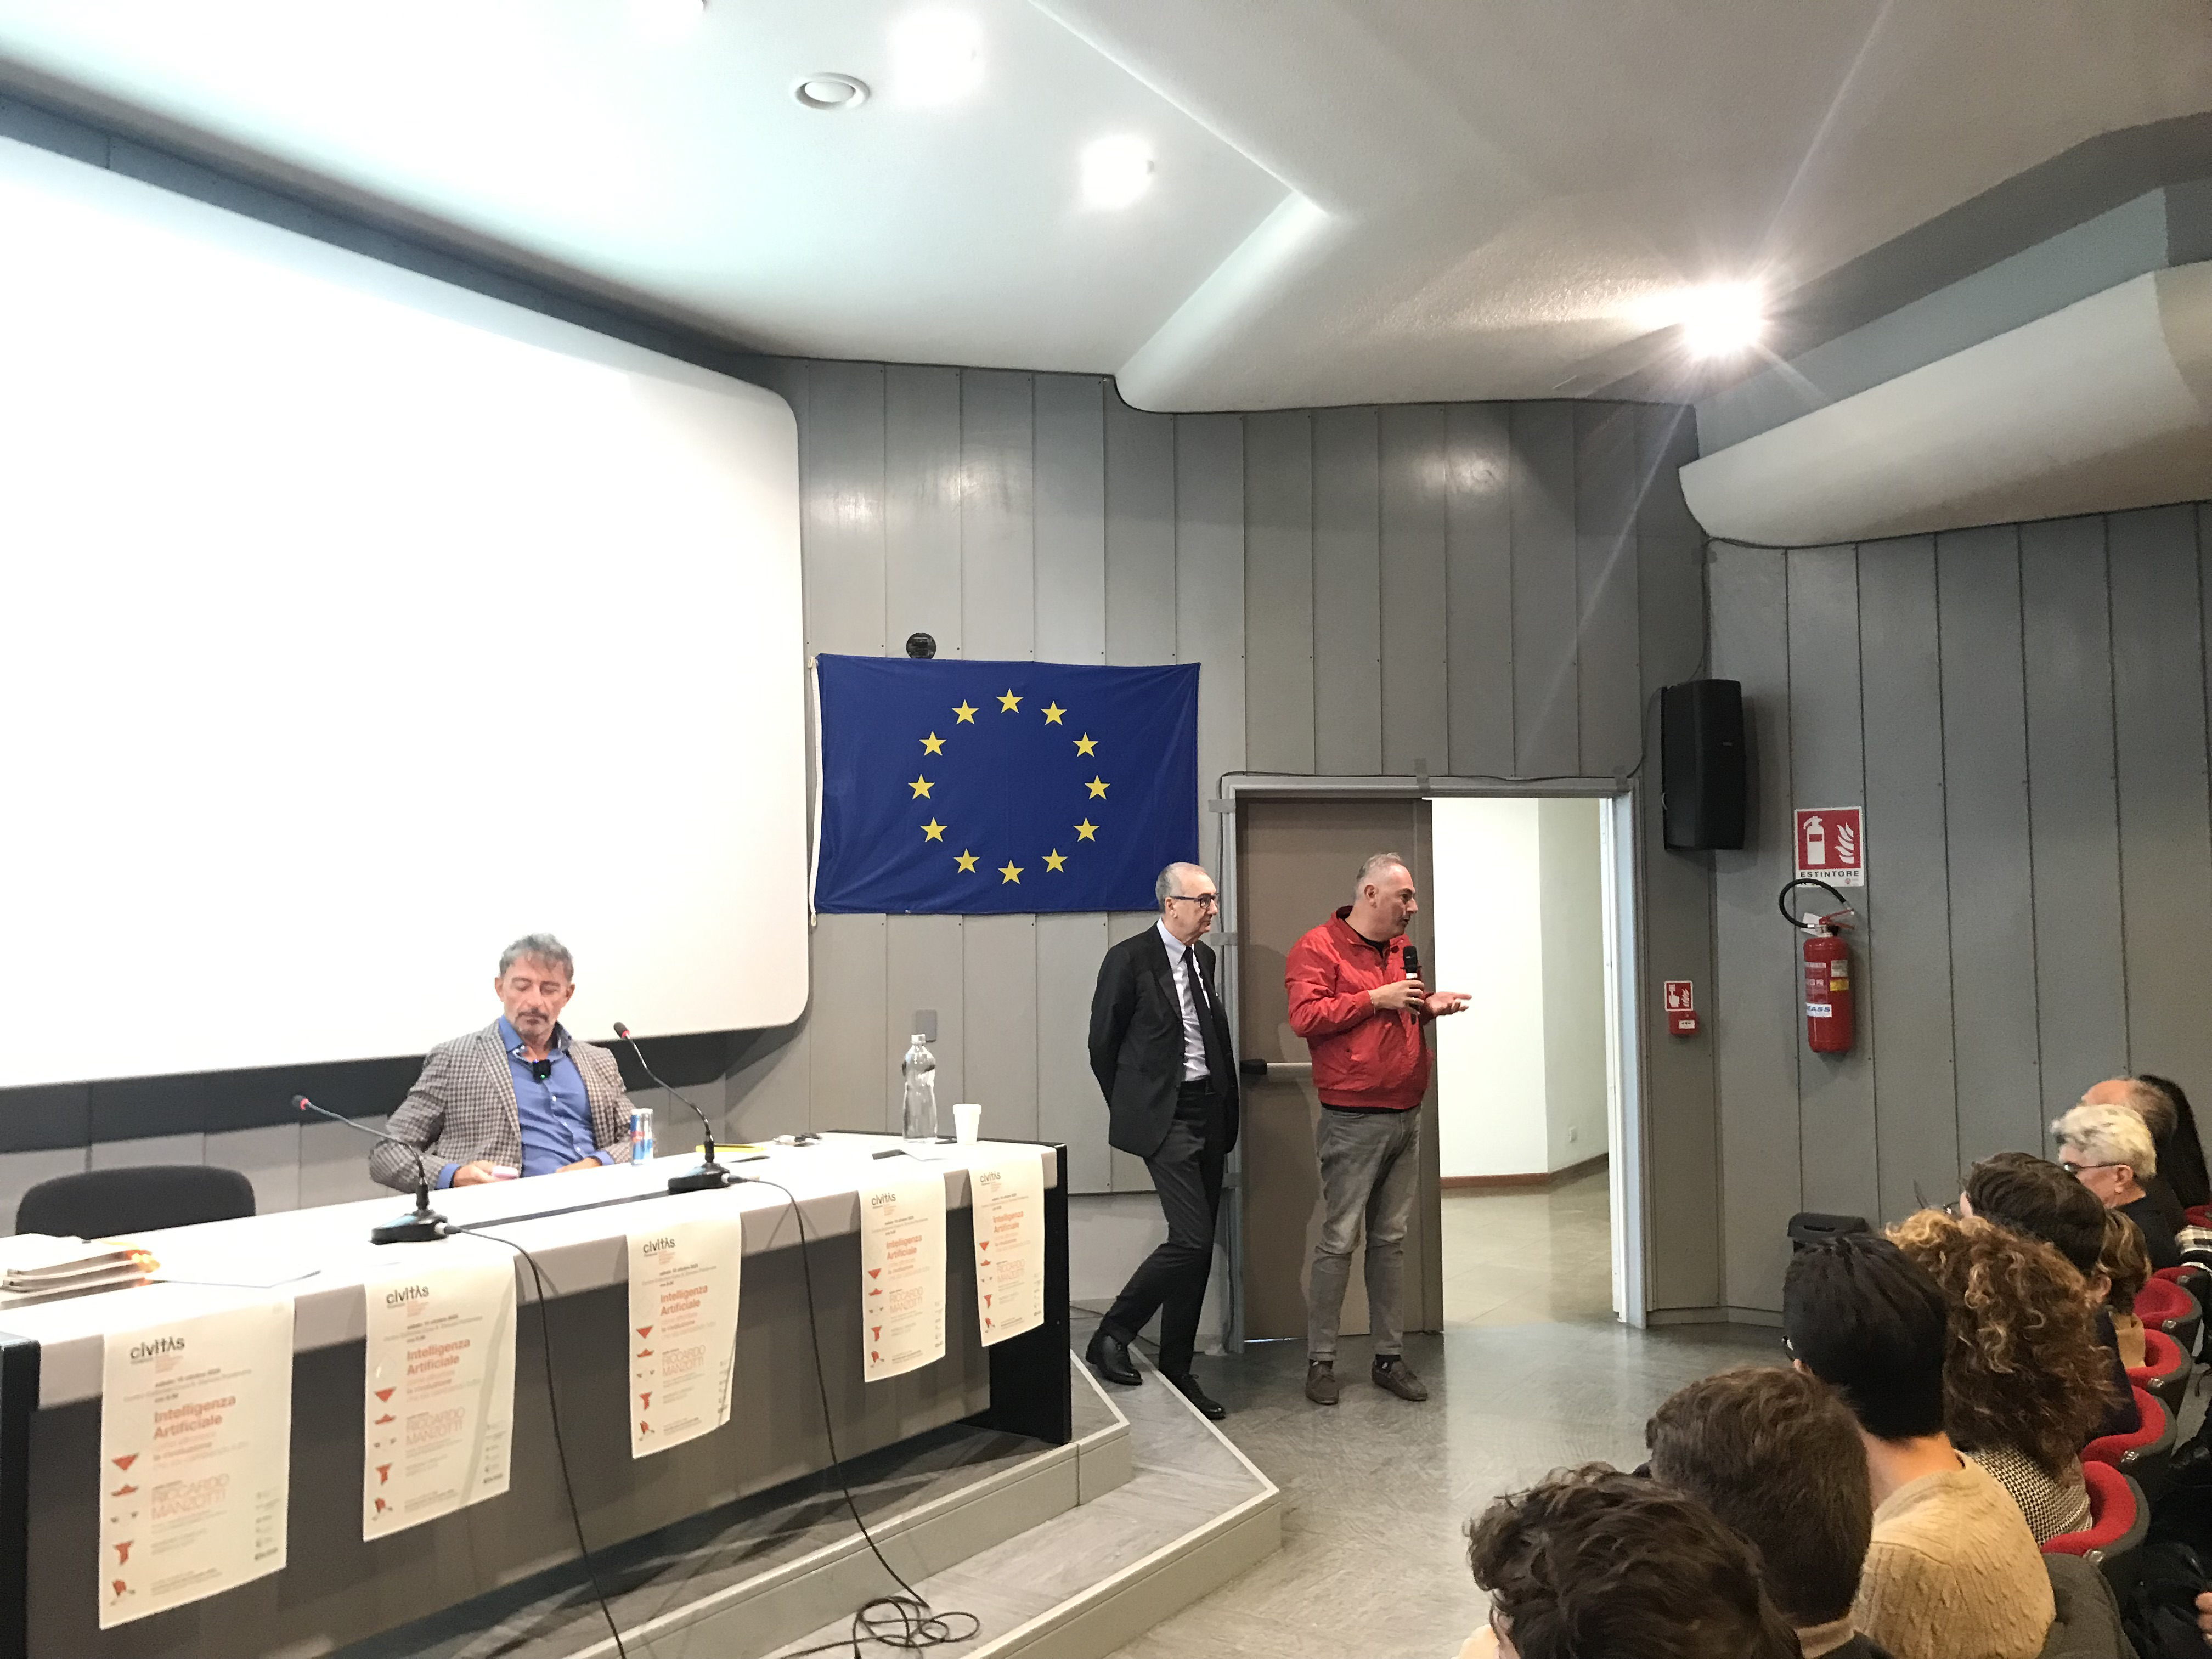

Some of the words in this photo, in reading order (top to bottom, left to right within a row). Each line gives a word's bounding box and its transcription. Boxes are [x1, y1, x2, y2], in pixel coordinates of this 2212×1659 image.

[660, 1285, 708, 1304] Intelligenza
[659, 1298, 701, 1316] Artificiale
[407, 1338, 470, 1361] Intelligenza
[407, 1355, 460, 1375] Artificiale
[154, 1395, 236, 1423] Intelligenza
[153, 1414, 223, 1440] Artificiale
